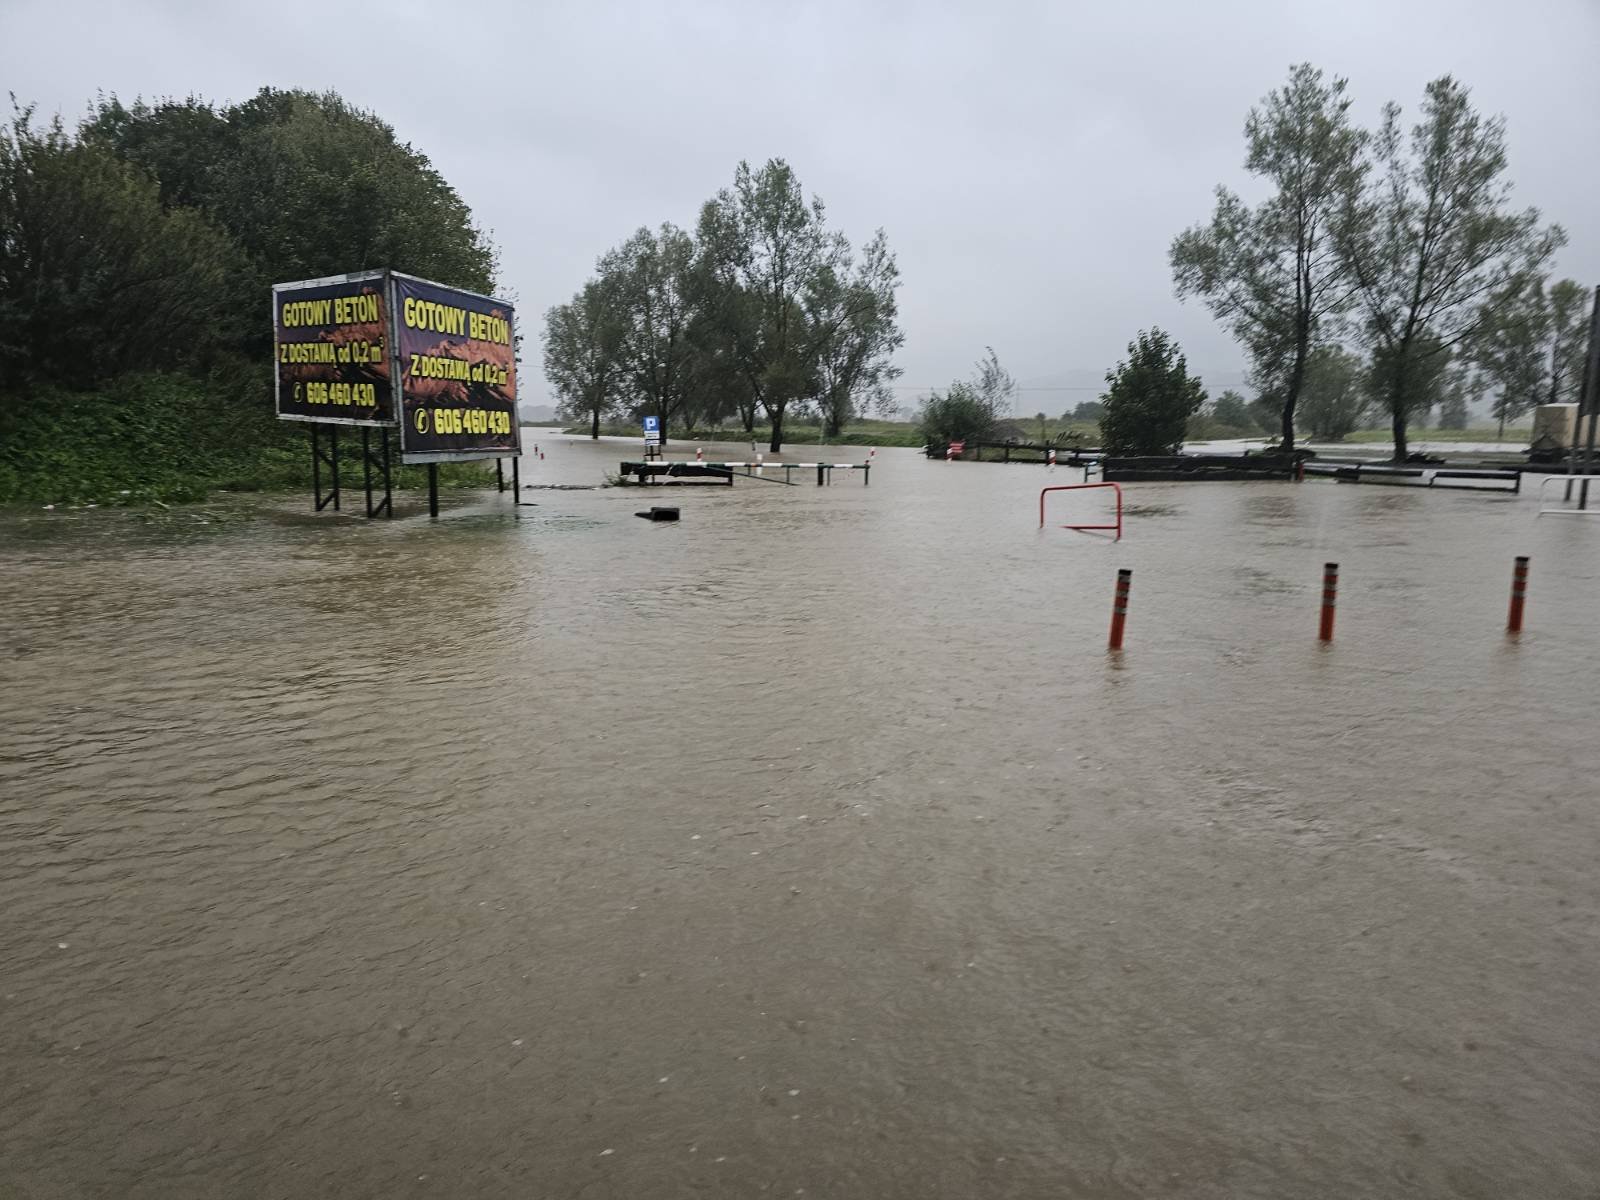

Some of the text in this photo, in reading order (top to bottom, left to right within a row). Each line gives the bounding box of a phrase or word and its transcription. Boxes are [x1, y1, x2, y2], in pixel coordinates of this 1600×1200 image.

[283, 295, 378, 327] GOTOWY BETON
[404, 297, 509, 344] GOTOWY BETON
[281, 344, 288, 363] Z
[289, 343, 336, 368] DOSTAWĄ
[338, 342, 350, 362] od
[353, 342, 369, 367] 0,2
[411, 355, 420, 376] Z
[421, 357, 471, 386] DOSTAWĄ
[472, 365, 483, 380] od
[485, 365, 497, 386] 0,2
[307, 383, 375, 406] 606 460 430
[435, 409, 510, 434] 606 460 430
[646, 417, 656, 429] P
